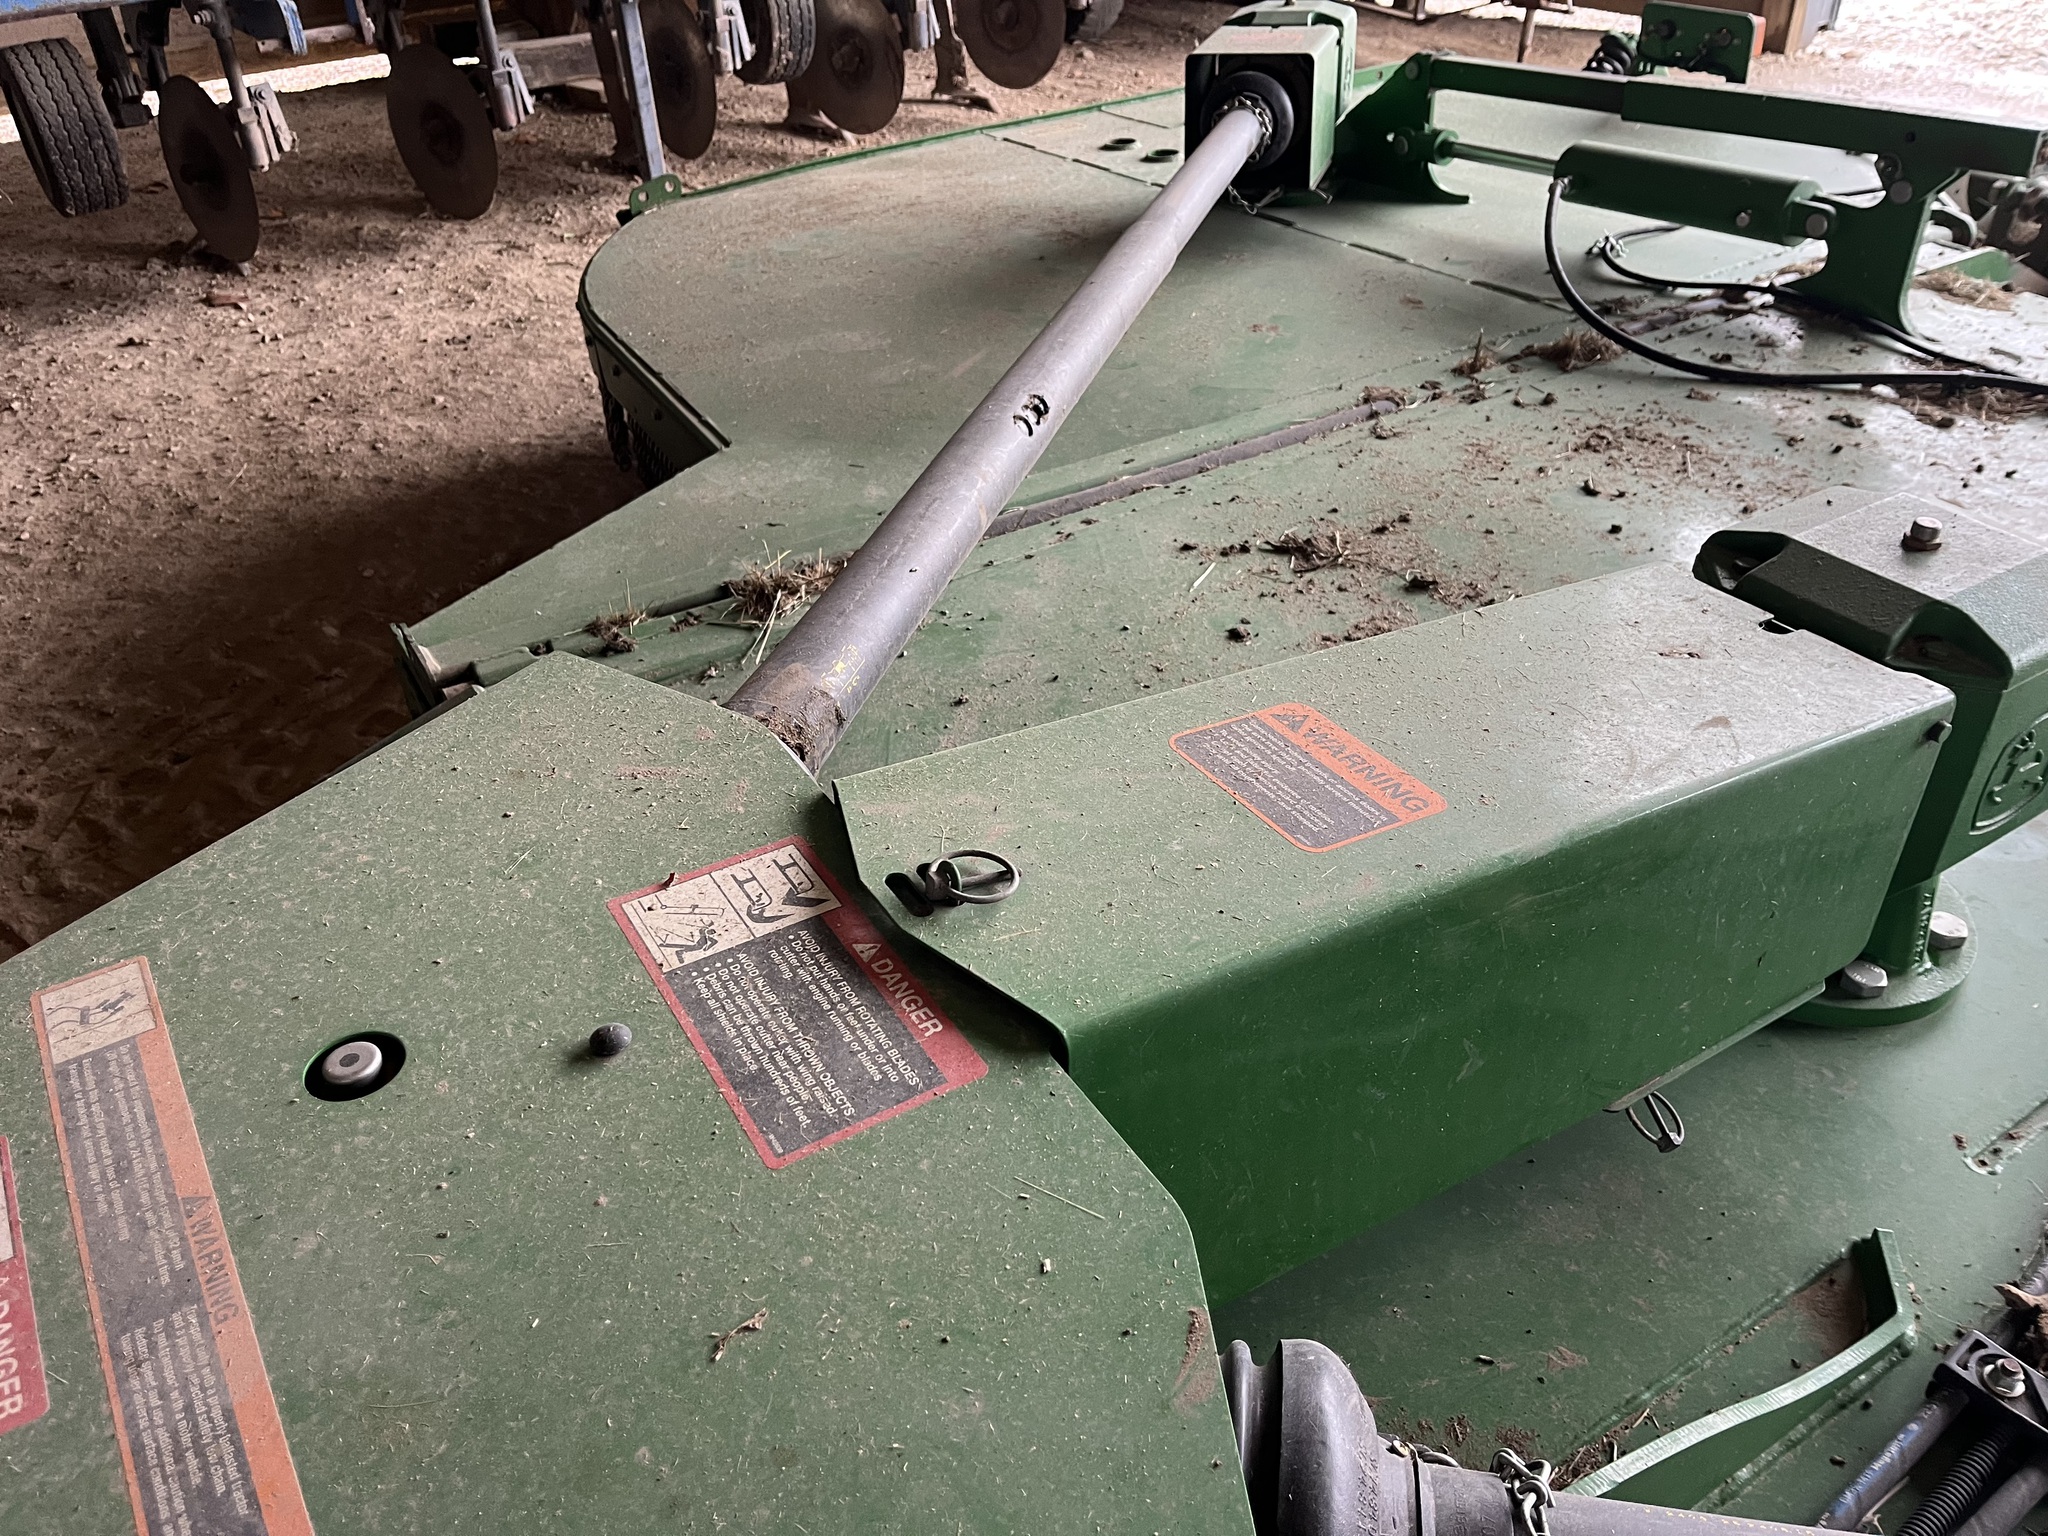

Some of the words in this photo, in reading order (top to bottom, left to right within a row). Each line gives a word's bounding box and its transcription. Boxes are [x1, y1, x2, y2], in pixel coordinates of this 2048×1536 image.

[1303, 729, 1430, 813] WARNING
[768, 949, 793, 981] rotating.
[693, 977, 712, 999] Keep
[705, 972, 727, 999] Debris
[870, 958, 943, 1038] DANGER
[706, 998, 721, 1010] all
[722, 998, 737, 1015] can
[732, 1013, 746, 1026] be
[779, 945, 800, 967] cutter
[796, 968, 813, 984] with
[808, 984, 832, 1011] engine
[827, 1010, 855, 1042] running
[850, 1041, 862, 1052] or
[857, 1051, 883, 1081] blades
[791, 939, 804, 952] Do
[799, 952, 815, 966] not
[807, 965, 825, 979] put
[819, 977, 841, 1003] hands
[836, 1002, 849, 1012] or
[844, 1011, 862, 1028] feet
[856, 1028, 879, 1053] under
[874, 1053, 887, 1064] or
[881, 1063, 900, 1083] into
[797, 930, 821, 953] AVOID
[815, 952, 843, 981] INJURY
[837, 981, 862, 1007] FROM
[855, 1006, 893, 1049] ROTATING
[887, 1048, 920, 1086] BLADES
[713, 1008, 737, 1038] shields
[717, 967, 730, 981] Do
[725, 980, 741, 995] not
[734, 994, 761, 1025] operate
[755, 1025, 777, 1049] cutter
[771, 1050, 790, 1070] near
[783, 1070, 813, 1104] people.
[736, 953, 760, 977] AVOID
[754, 976, 781, 1006] INJURY
[774, 1006, 798, 1033] FROM
[793, 1032, 826, 1073] THROWN
[819, 1072, 855, 1116] OBJECTS
[729, 963, 742, 976] Do
[747, 989, 772, 1020] operate
[784, 1044, 802, 1065] with
[797, 1063, 817, 1087] wing
[812, 1086, 838, 1117] raised.
[731, 1036, 743, 1048] in
[740, 1024, 764, 1055] thrown
[735, 1046, 759, 1074] place.
[759, 1053, 791, 1096] hundreds
[785, 1095, 800, 1106] of
[792, 1105, 812, 1129] feet.
[190, 1214, 239, 1325] WARNING
[171, 1311, 186, 1329] and
